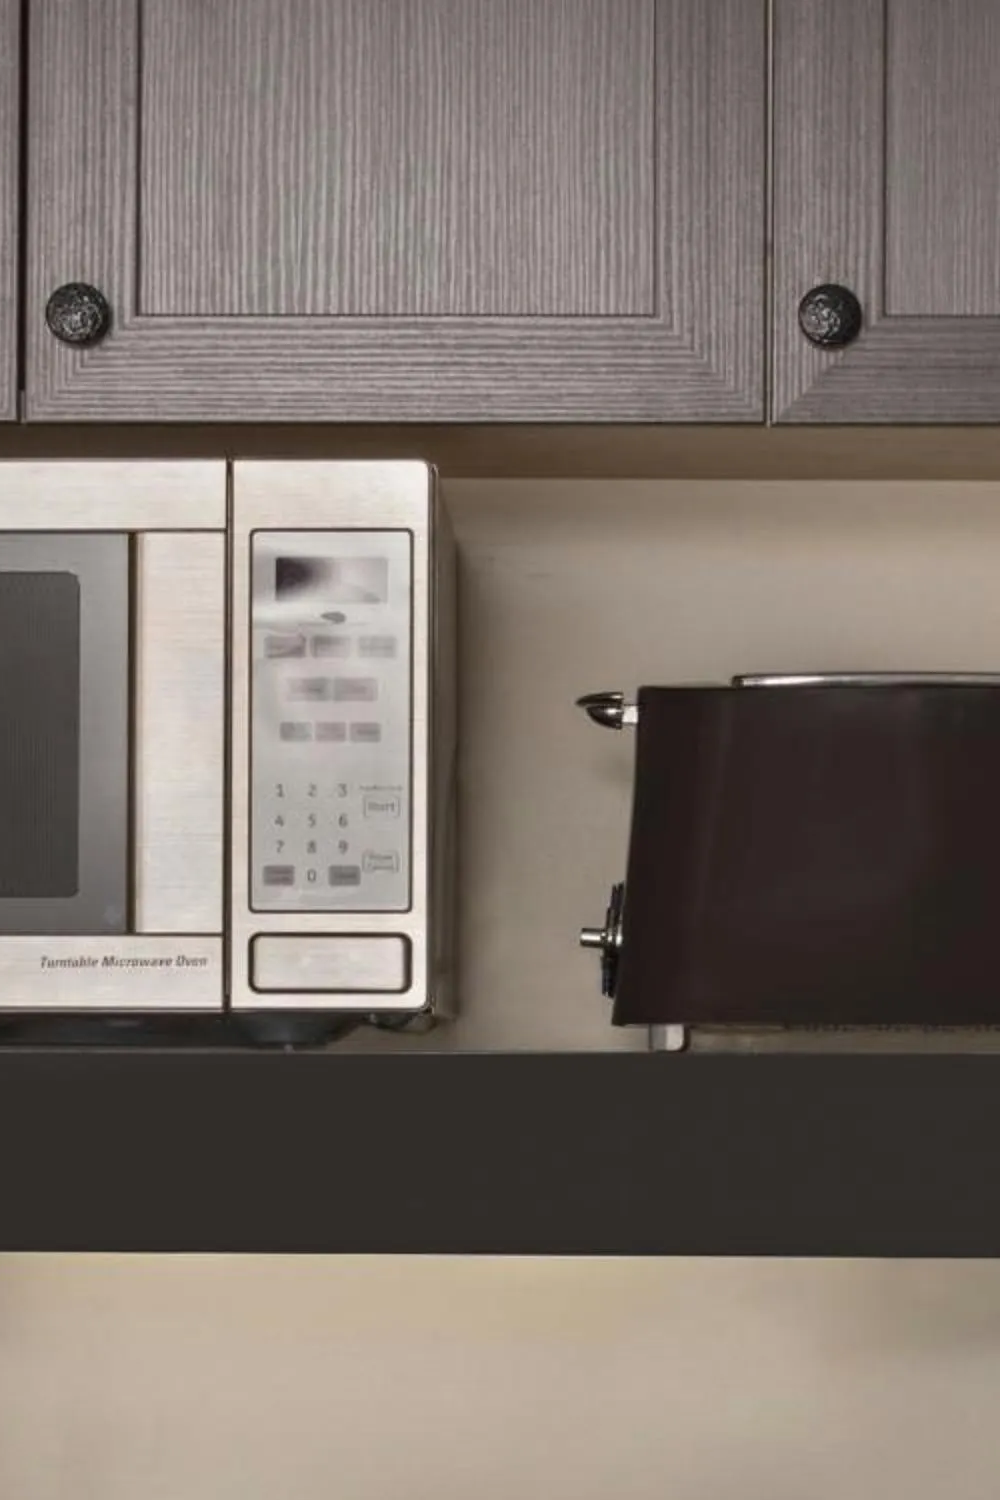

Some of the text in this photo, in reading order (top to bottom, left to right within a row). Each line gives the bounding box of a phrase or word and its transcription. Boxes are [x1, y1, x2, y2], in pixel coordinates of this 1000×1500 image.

[275, 783, 284, 798] 1
[307, 782, 317, 797] 2
[338, 783, 348, 798] 3
[275, 815, 285, 827] 4
[307, 813, 317, 828] 5
[338, 813, 348, 828] 6
[276, 839, 285, 853] 7
[307, 840, 317, 854] 8
[338, 840, 348, 854] 9
[307, 868, 317, 882] 0
[40, 955, 208, 968] Turntable Microwave Oven
